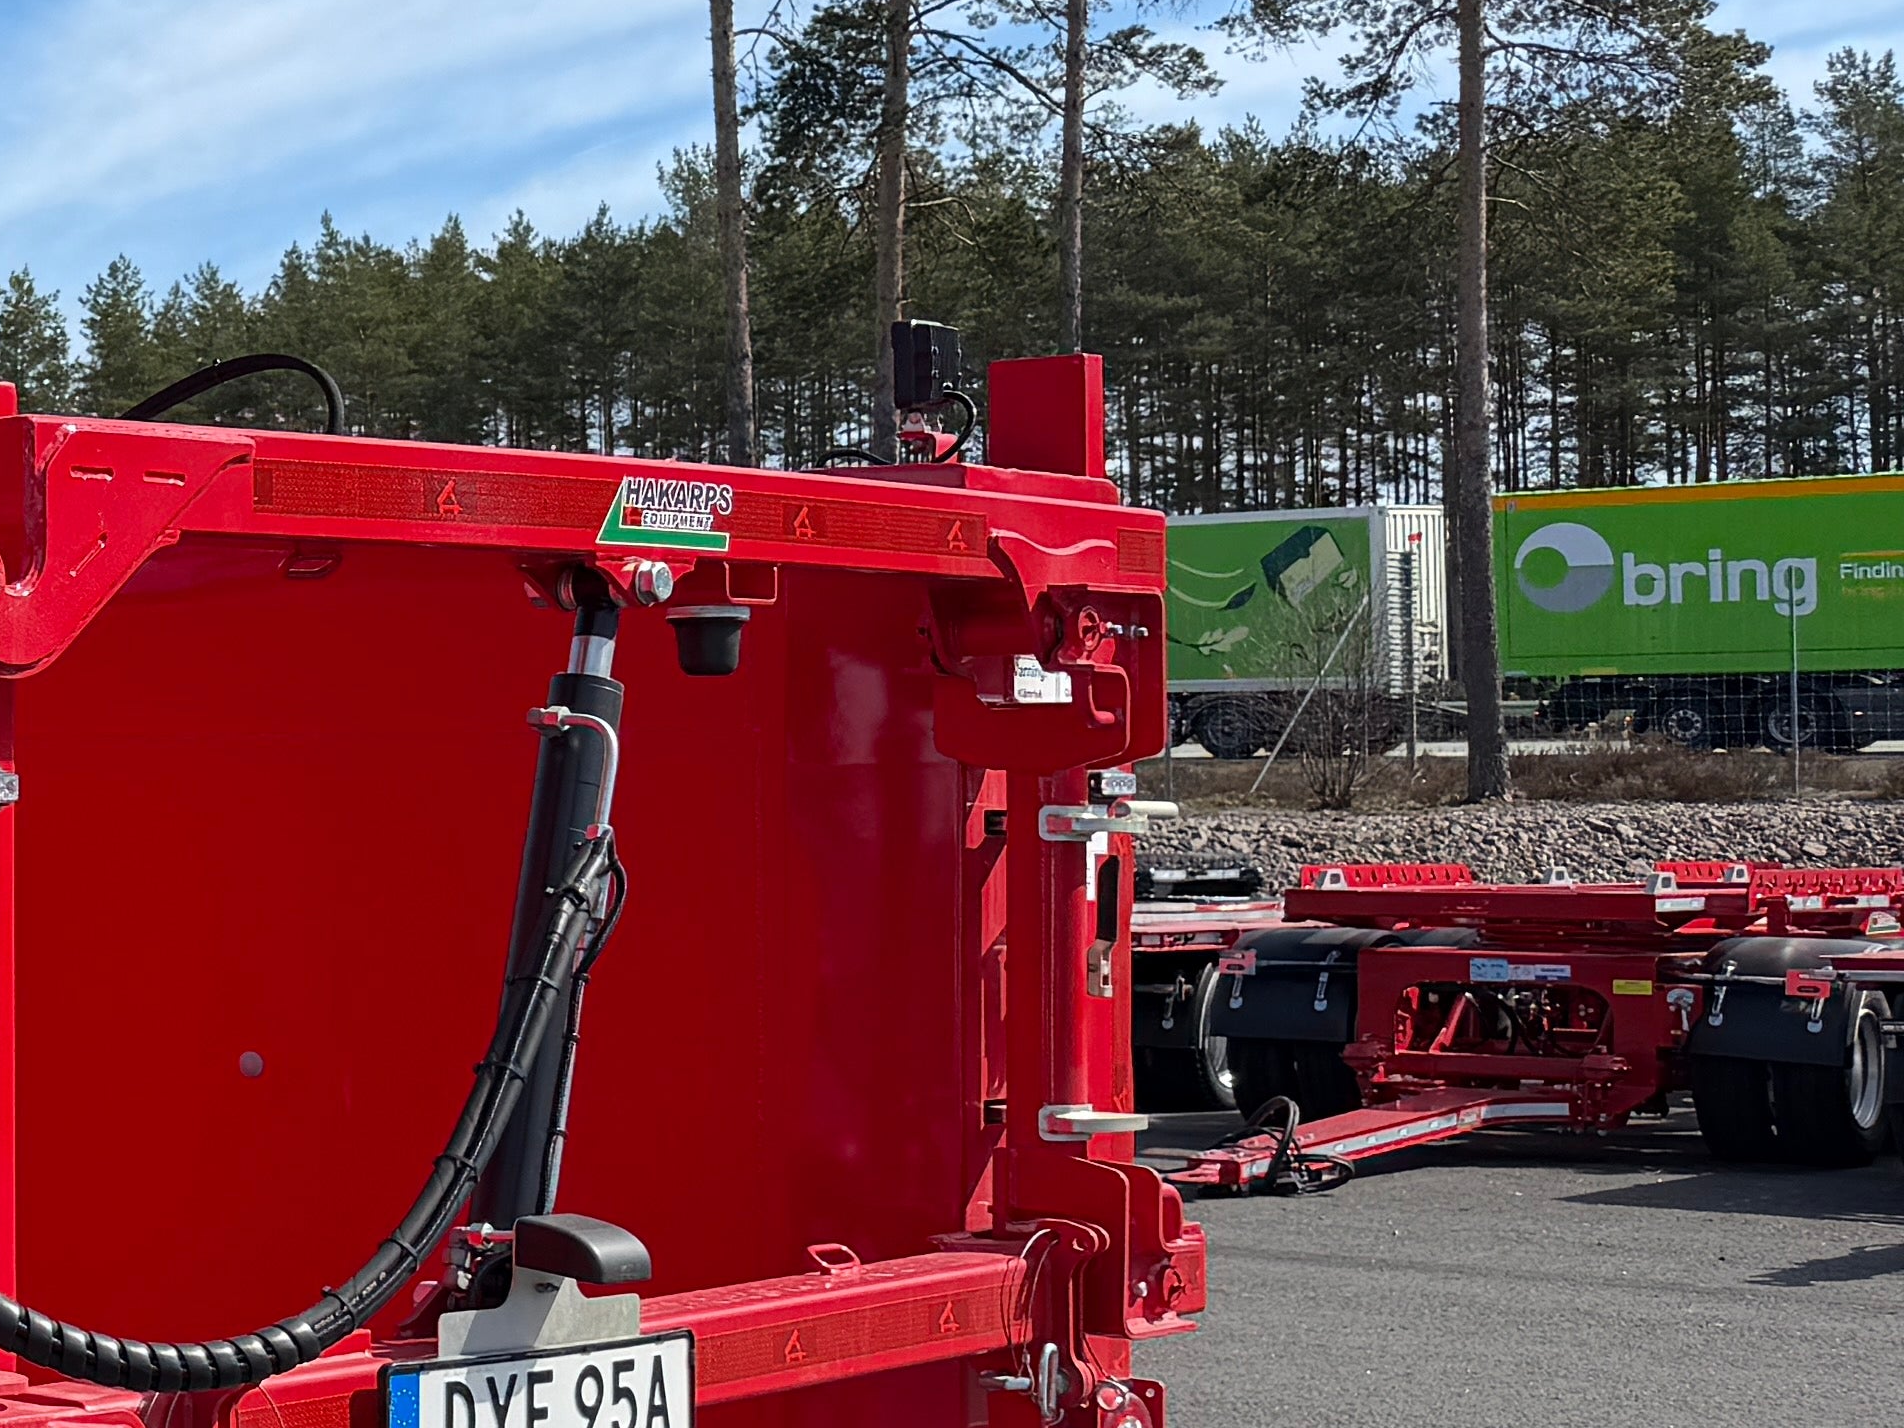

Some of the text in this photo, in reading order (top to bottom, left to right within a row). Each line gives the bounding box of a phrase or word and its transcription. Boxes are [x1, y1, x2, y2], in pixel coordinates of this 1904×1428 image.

[624, 476, 733, 515] HAKARPS
[642, 510, 713, 531] EQUIPMENT
[1622, 548, 1817, 616] bring
